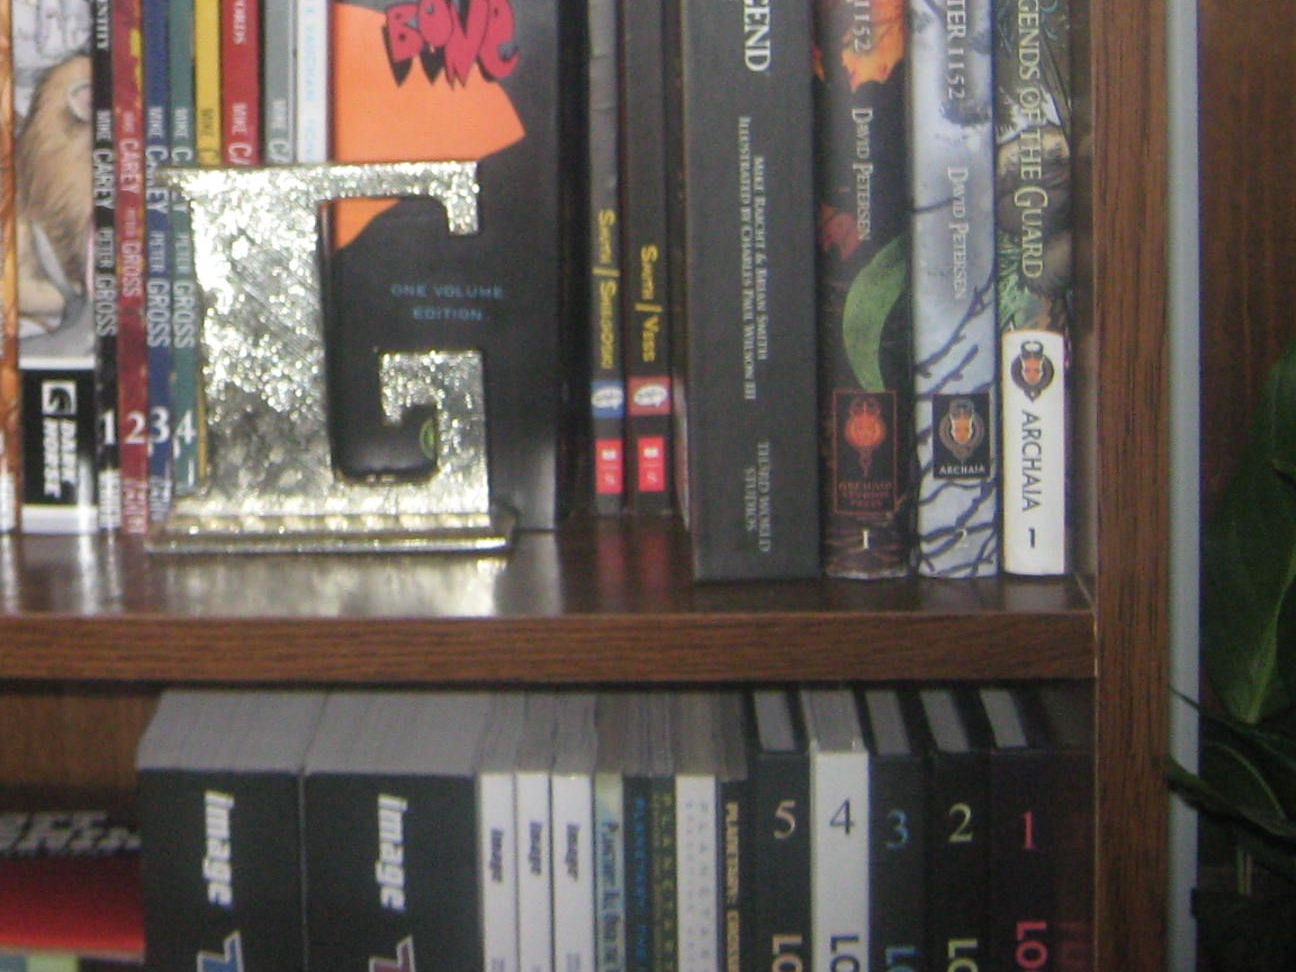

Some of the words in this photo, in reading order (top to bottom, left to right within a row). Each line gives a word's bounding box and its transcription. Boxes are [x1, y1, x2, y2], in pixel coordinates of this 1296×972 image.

[853, 0, 873, 53] 1152
[947, 47, 966, 100] 1152
[148, 106, 164, 139] MIKE
[173, 107, 190, 139] MIKE
[232, 102, 248, 136] MIKE
[1018, 86, 1043, 126] OF
[851, 106, 875, 159] DAVID
[1020, 129, 1043, 180] THE
[93, 147, 114, 210] CAREY
[121, 137, 141, 194] CAREY
[852, 161, 875, 242] PETERSEN
[946, 165, 969, 218] DAVID
[1013, 185, 1048, 279] GUARD
[121, 240, 142, 298] GROSS
[950, 222, 970, 300] PETERSEN
[95, 273, 118, 337] GROSS
[146, 279, 170, 348] GROSS
[173, 280, 196, 349] GROSS
[412, 308, 484, 322] EDITION
[434, 284, 503, 299] VOLUME
[742, 288, 755, 324] PAUL
[756, 314, 769, 361] SMITH
[103, 410, 115, 445] 1
[124, 410, 146, 445] 2
[148, 406, 170, 445] 3
[176, 410, 197, 445] 4
[43, 417, 60, 499] HORSE
[61, 418, 77, 486] DARK
[1021, 409, 1042, 513] ARCHAIA
[1028, 527, 1037, 549] 1
[773, 800, 797, 840] 5
[829, 799, 855, 836] 4
[887, 810, 910, 851] 3
[948, 803, 973, 843] 2
[1023, 810, 1035, 851] 1
[204, 790, 236, 909] Image
[374, 793, 408, 911] Image
